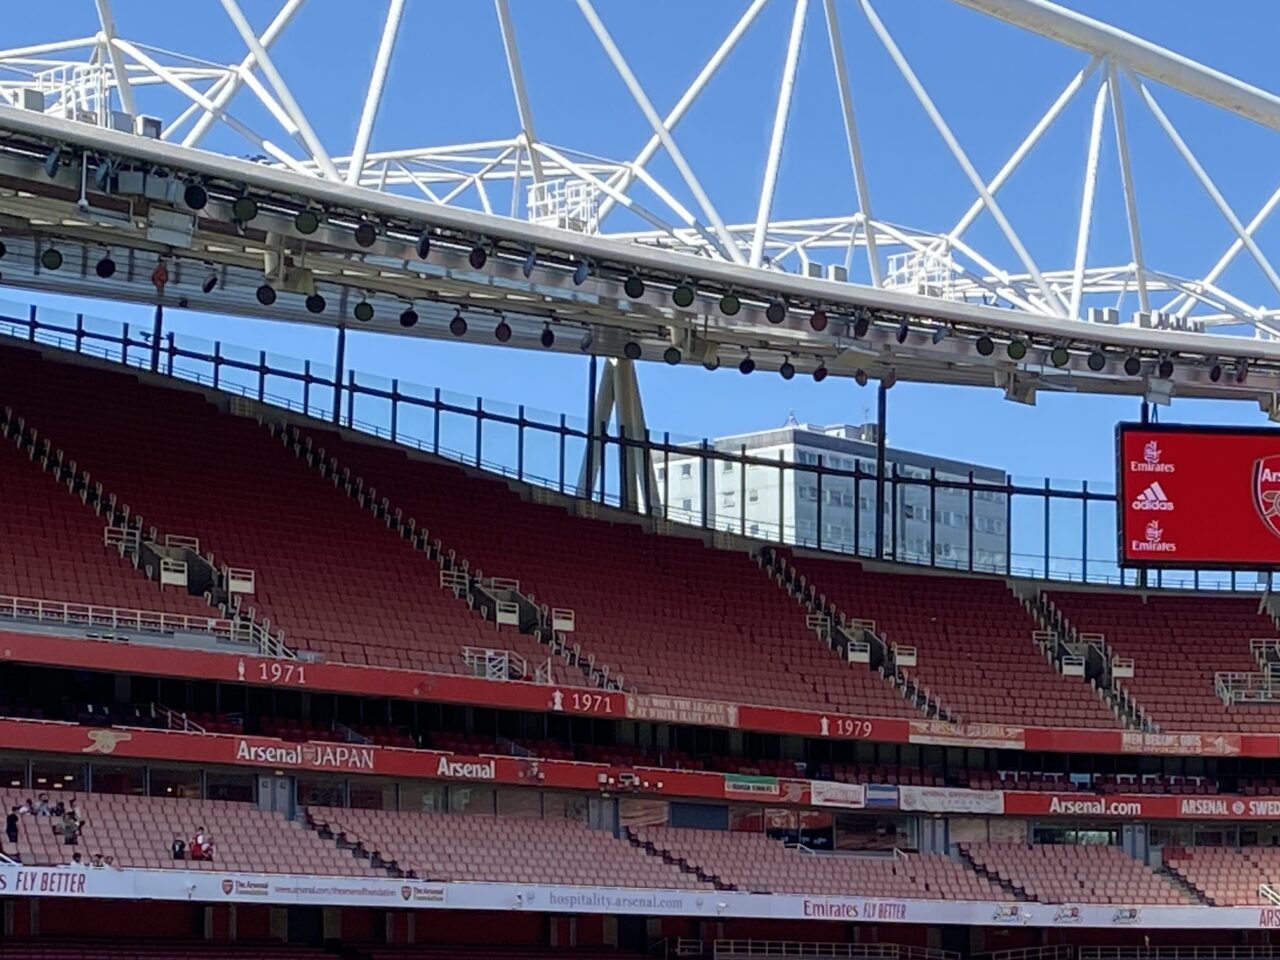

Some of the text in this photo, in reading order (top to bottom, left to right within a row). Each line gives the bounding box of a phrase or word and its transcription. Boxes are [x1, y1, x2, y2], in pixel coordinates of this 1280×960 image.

[1131, 461, 1175, 473] Emirates
[1132, 500, 1174, 511] adidas
[1132, 541, 1176, 552] Emirates
[259, 662, 306, 684] 1971
[572, 693, 612, 713] 1971
[836, 719, 872, 737] 1979
[236, 740, 374, 769] Arsenal JAPAN
[437, 757, 495, 779] Arsenal
[1049, 797, 1141, 815] Arsenal.com
[1181, 800, 1229, 814] ARSENAL
[15, 871, 37, 892] FLY
[39, 872, 86, 893] BETTER
[549, 892, 683, 909] hospitality.arsenal.com
[803, 900, 906, 919] Emirates FLY BETTER
